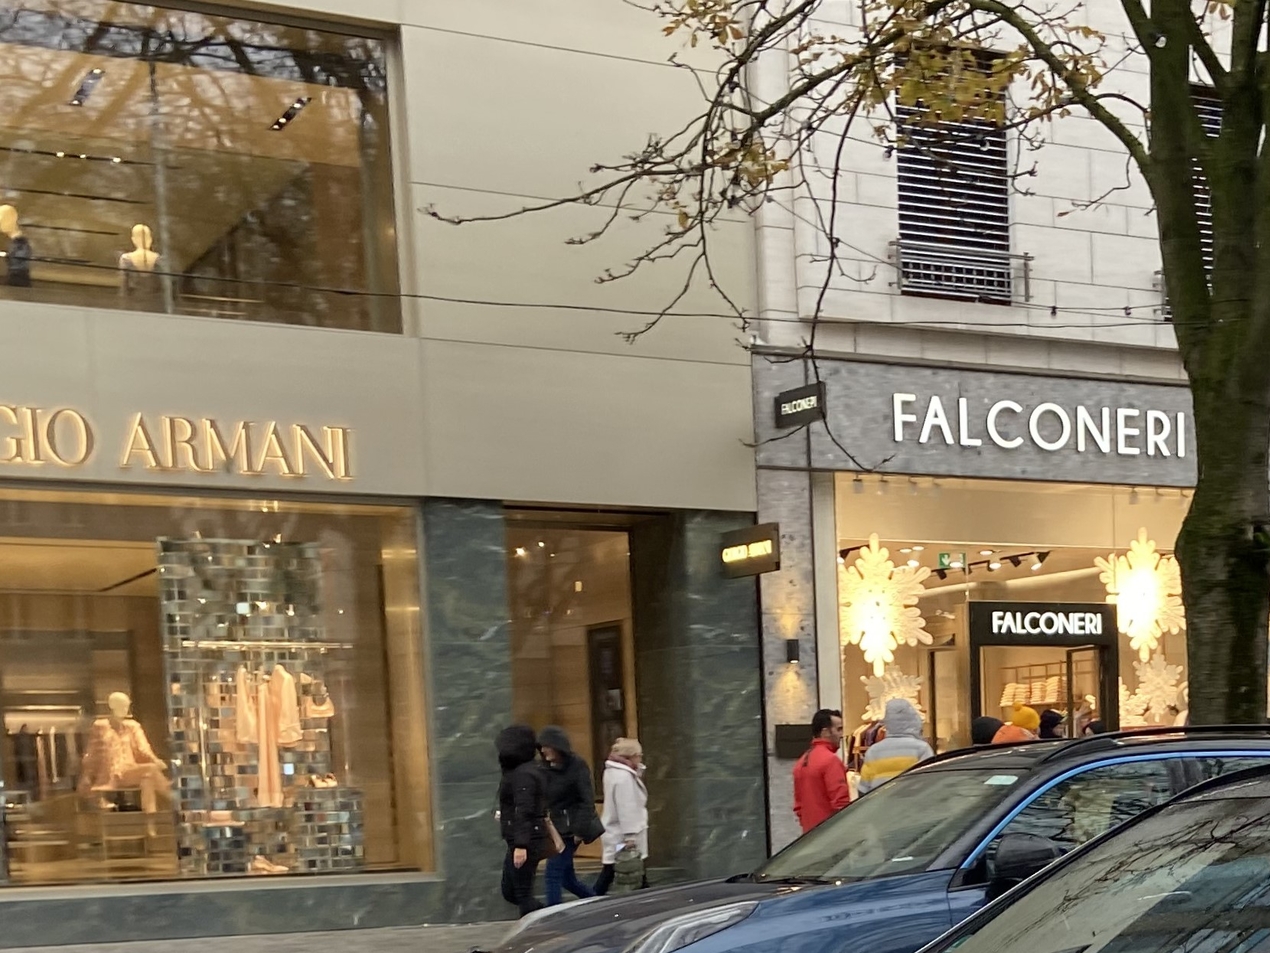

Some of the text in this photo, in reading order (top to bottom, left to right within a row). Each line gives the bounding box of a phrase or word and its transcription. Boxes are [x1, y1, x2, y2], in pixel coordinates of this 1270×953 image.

[119, 411, 357, 480] ARMANI
[893, 392, 1186, 458] FALCONERI
[991, 611, 1103, 635] FALCONERI
